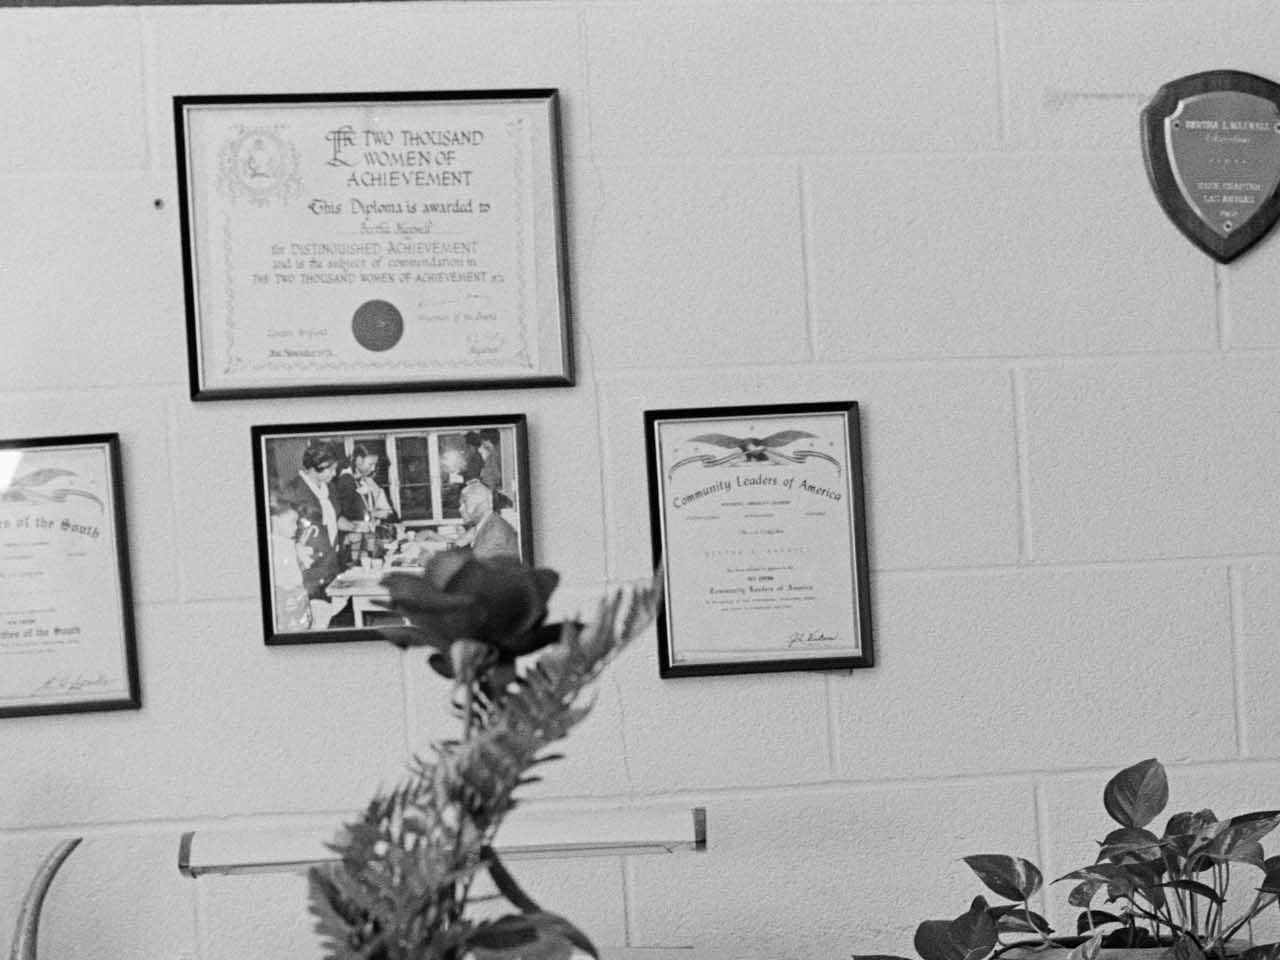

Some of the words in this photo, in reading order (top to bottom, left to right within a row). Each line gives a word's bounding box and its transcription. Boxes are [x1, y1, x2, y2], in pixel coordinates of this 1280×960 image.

[362, 130, 394, 147] TWO
[400, 130, 484, 147] THOUSAND
[363, 150, 431, 168] WOMEN
[434, 150, 456, 166] OF
[346, 170, 473, 187] ACHIEVEMENT
[307, 198, 342, 215] This
[350, 197, 402, 220] Diploma
[405, 200, 417, 214] is
[421, 199, 473, 214] awarded
[291, 242, 380, 256] DISTINGUISHED
[387, 240, 478, 255] ACHIEVEMENT
[301, 272, 356, 285] THOUSAND
[415, 271, 489, 283] ACHIEVEMENT
[673, 480, 732, 509] Community
[736, 473, 777, 488] Leaders
[783, 477, 795, 490] of
[799, 479, 842, 502] America
[60, 517, 100, 540] South
